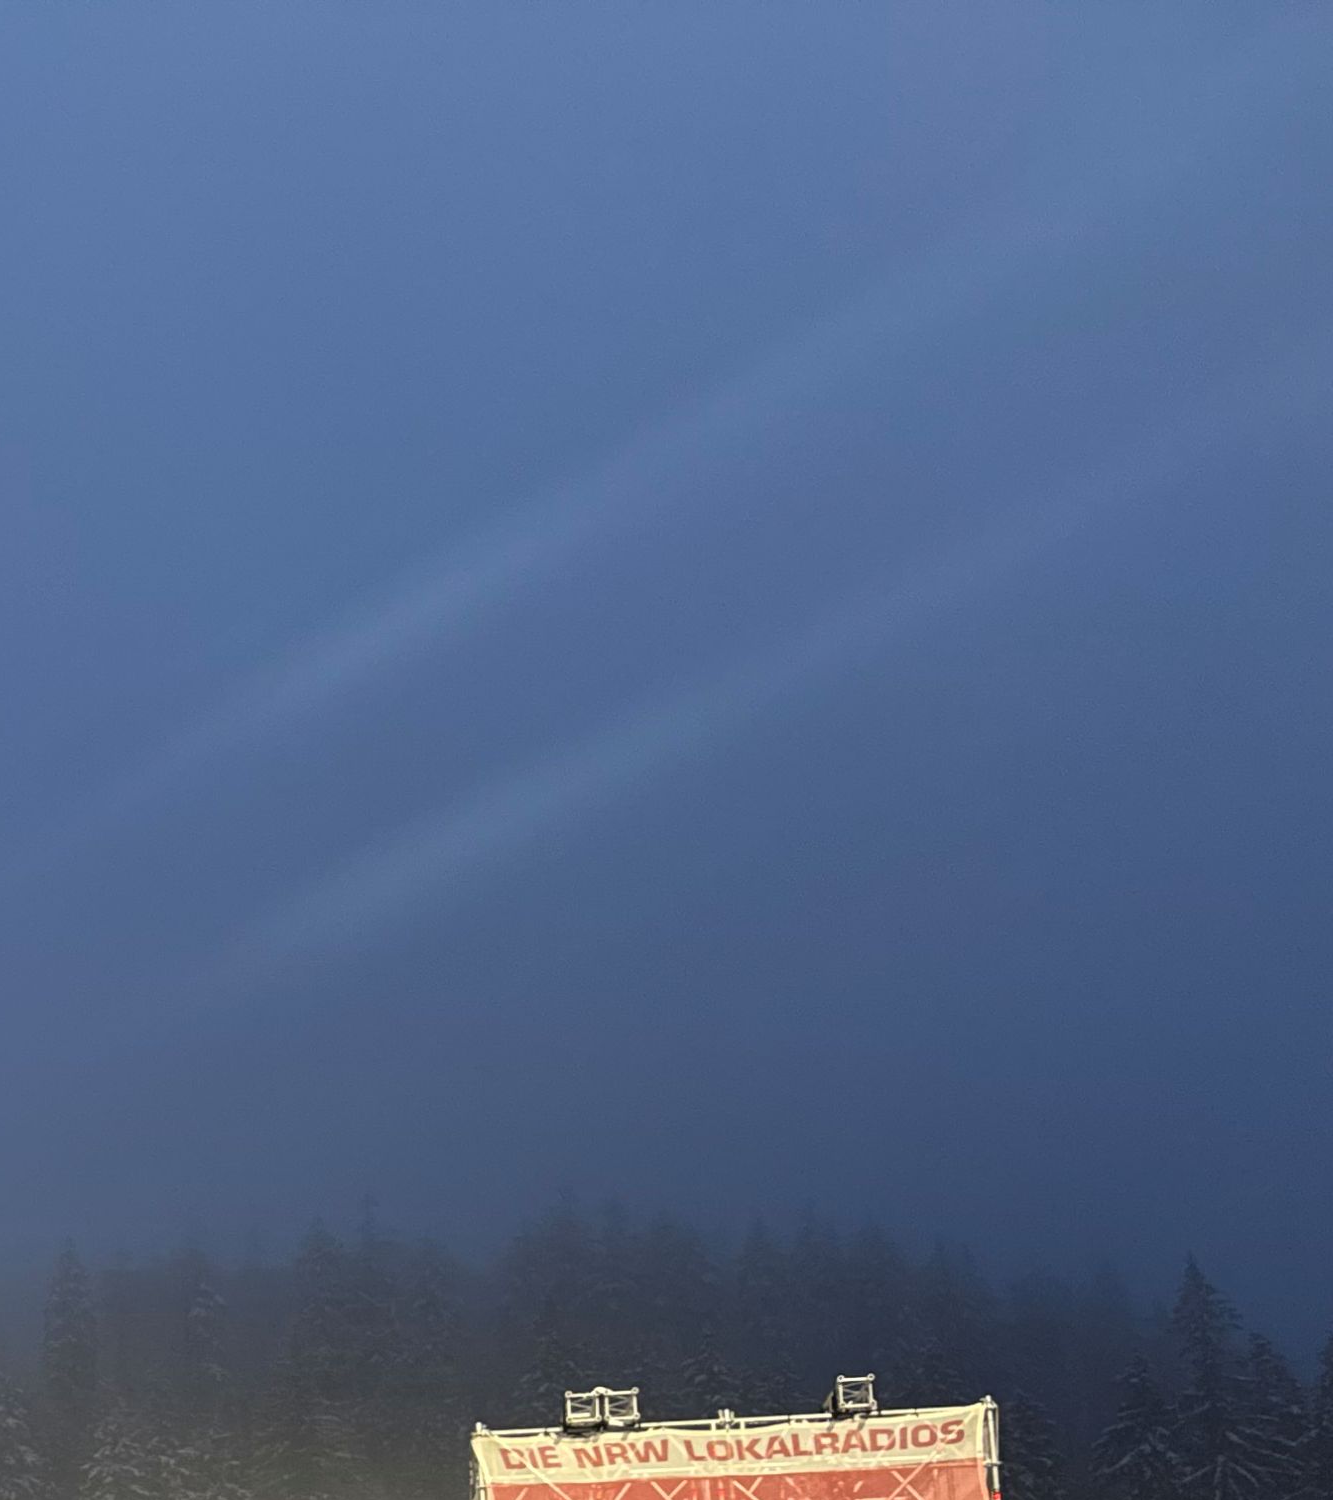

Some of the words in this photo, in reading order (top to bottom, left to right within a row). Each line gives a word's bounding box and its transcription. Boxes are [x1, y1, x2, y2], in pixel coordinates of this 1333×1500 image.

[502, 1445, 562, 1470] DIE
[572, 1438, 669, 1468] NRW
[683, 1418, 966, 1462] LOKALRADIOS
